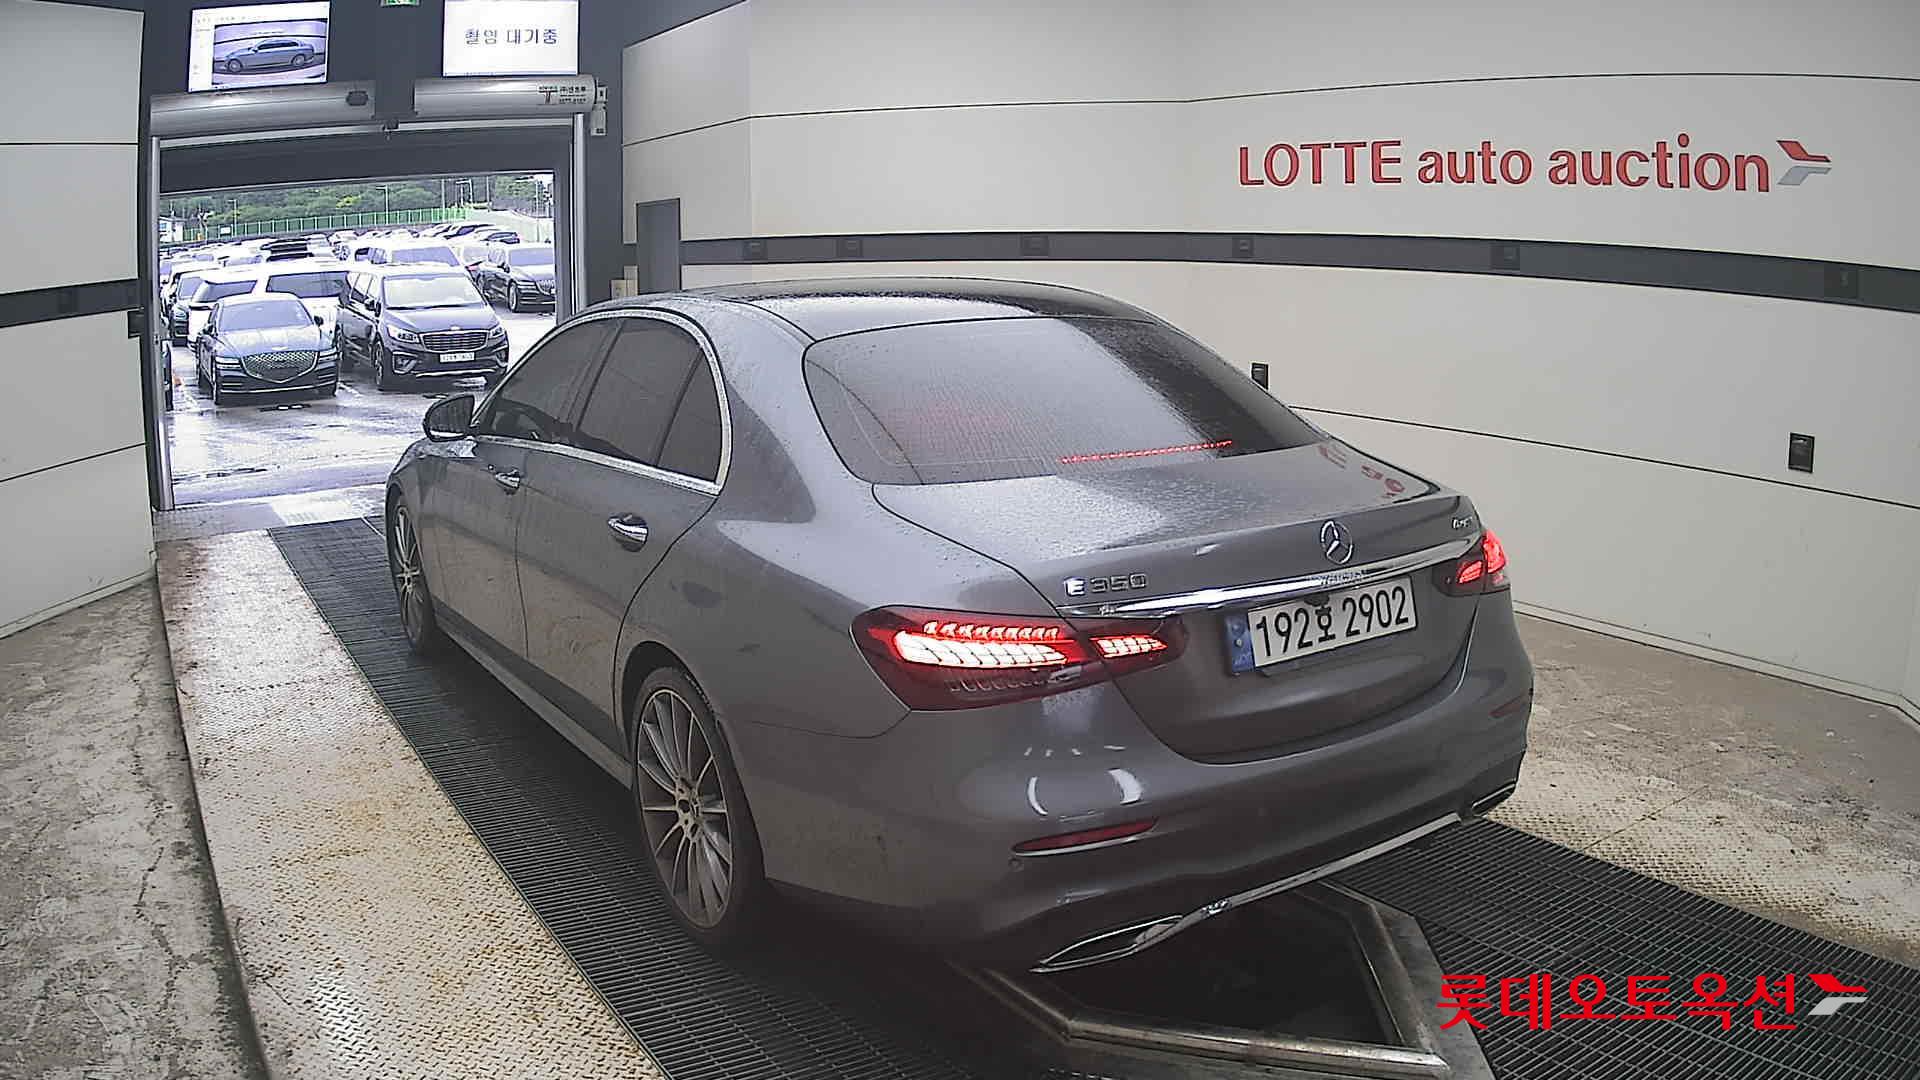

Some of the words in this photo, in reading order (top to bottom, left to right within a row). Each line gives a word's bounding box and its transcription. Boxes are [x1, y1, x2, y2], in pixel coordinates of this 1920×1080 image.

[506, 28, 558, 45] 대기중
[1239, 140, 1402, 187] LOTTE
[1417, 141, 1533, 186] auto
[1547, 132, 1770, 193] auction
[1064, 577, 1086, 597] E
[1090, 572, 1147, 594] 350
[1256, 606, 1336, 657] 192호
[1342, 586, 1409, 638] 2902
